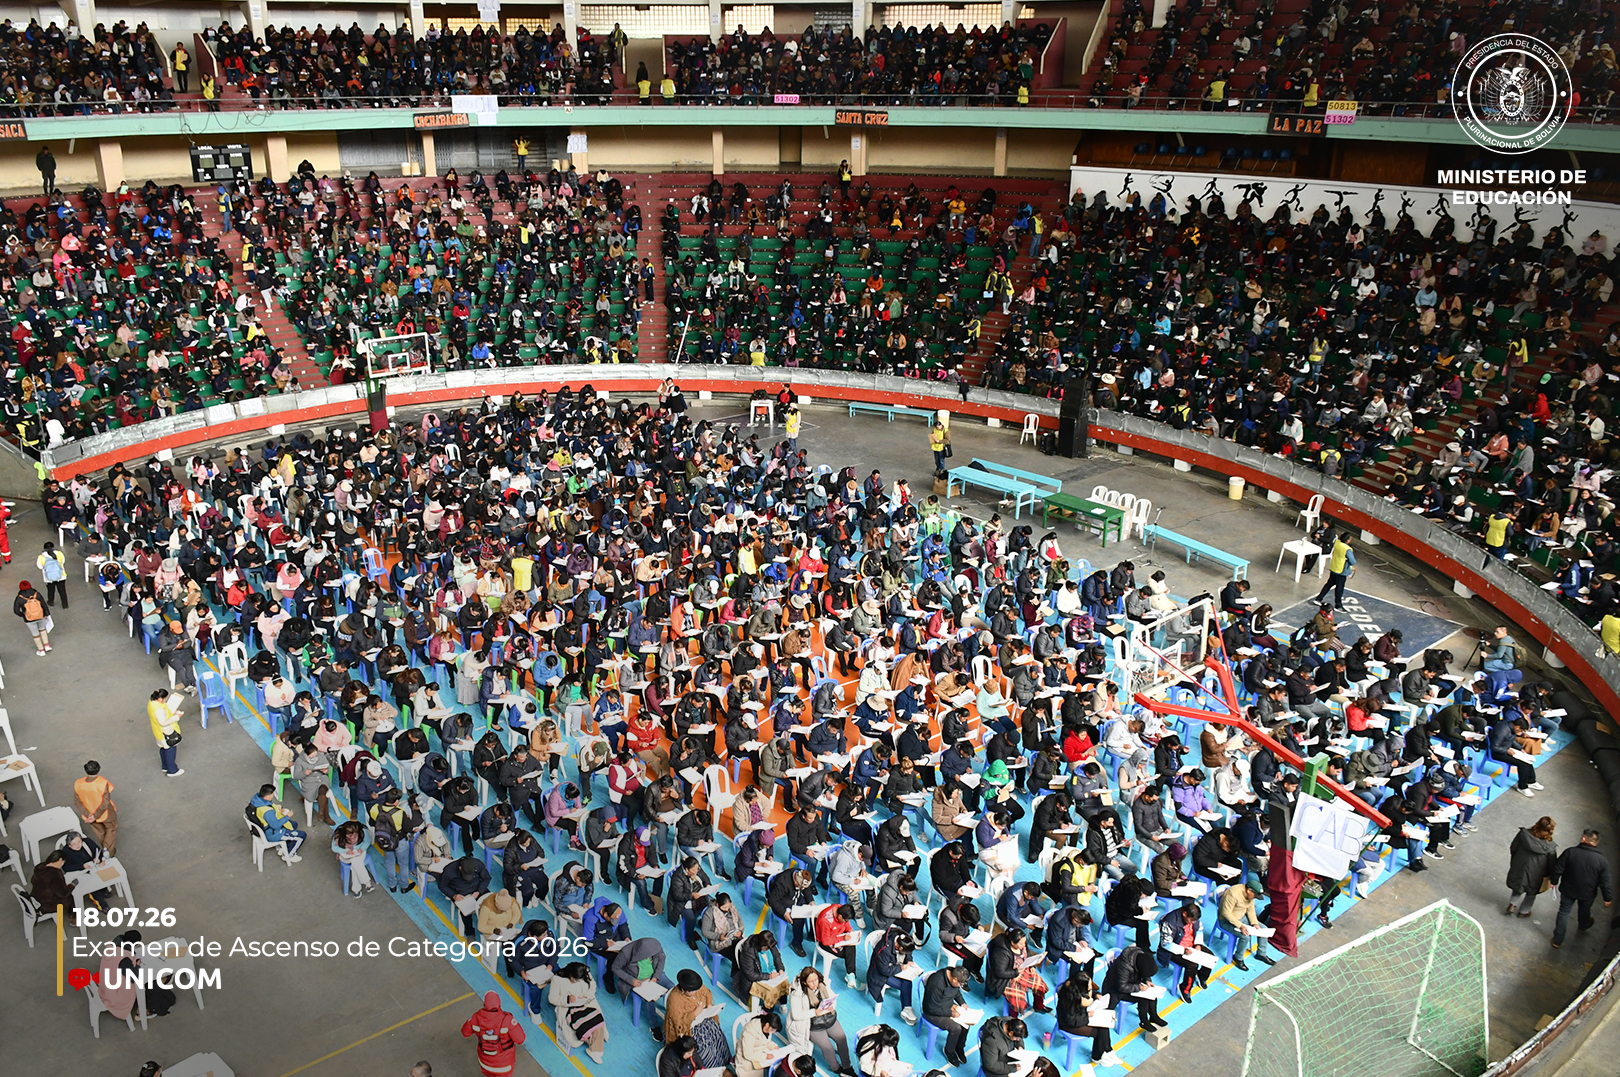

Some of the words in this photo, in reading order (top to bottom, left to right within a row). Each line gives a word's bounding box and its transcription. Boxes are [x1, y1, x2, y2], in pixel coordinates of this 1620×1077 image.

[775, 95, 799, 103] 51302
[1328, 102, 1357, 110] 50813
[414, 113, 469, 128] COCHABAMBA
[836, 112, 862, 124] SANTA
[864, 113, 889, 125] CRUZ
[1325, 115, 1354, 124] 51302
[1273, 117, 1290, 132] LA
[1295, 118, 1323, 134] PAZ
[1296, 801, 1366, 856] CAB
